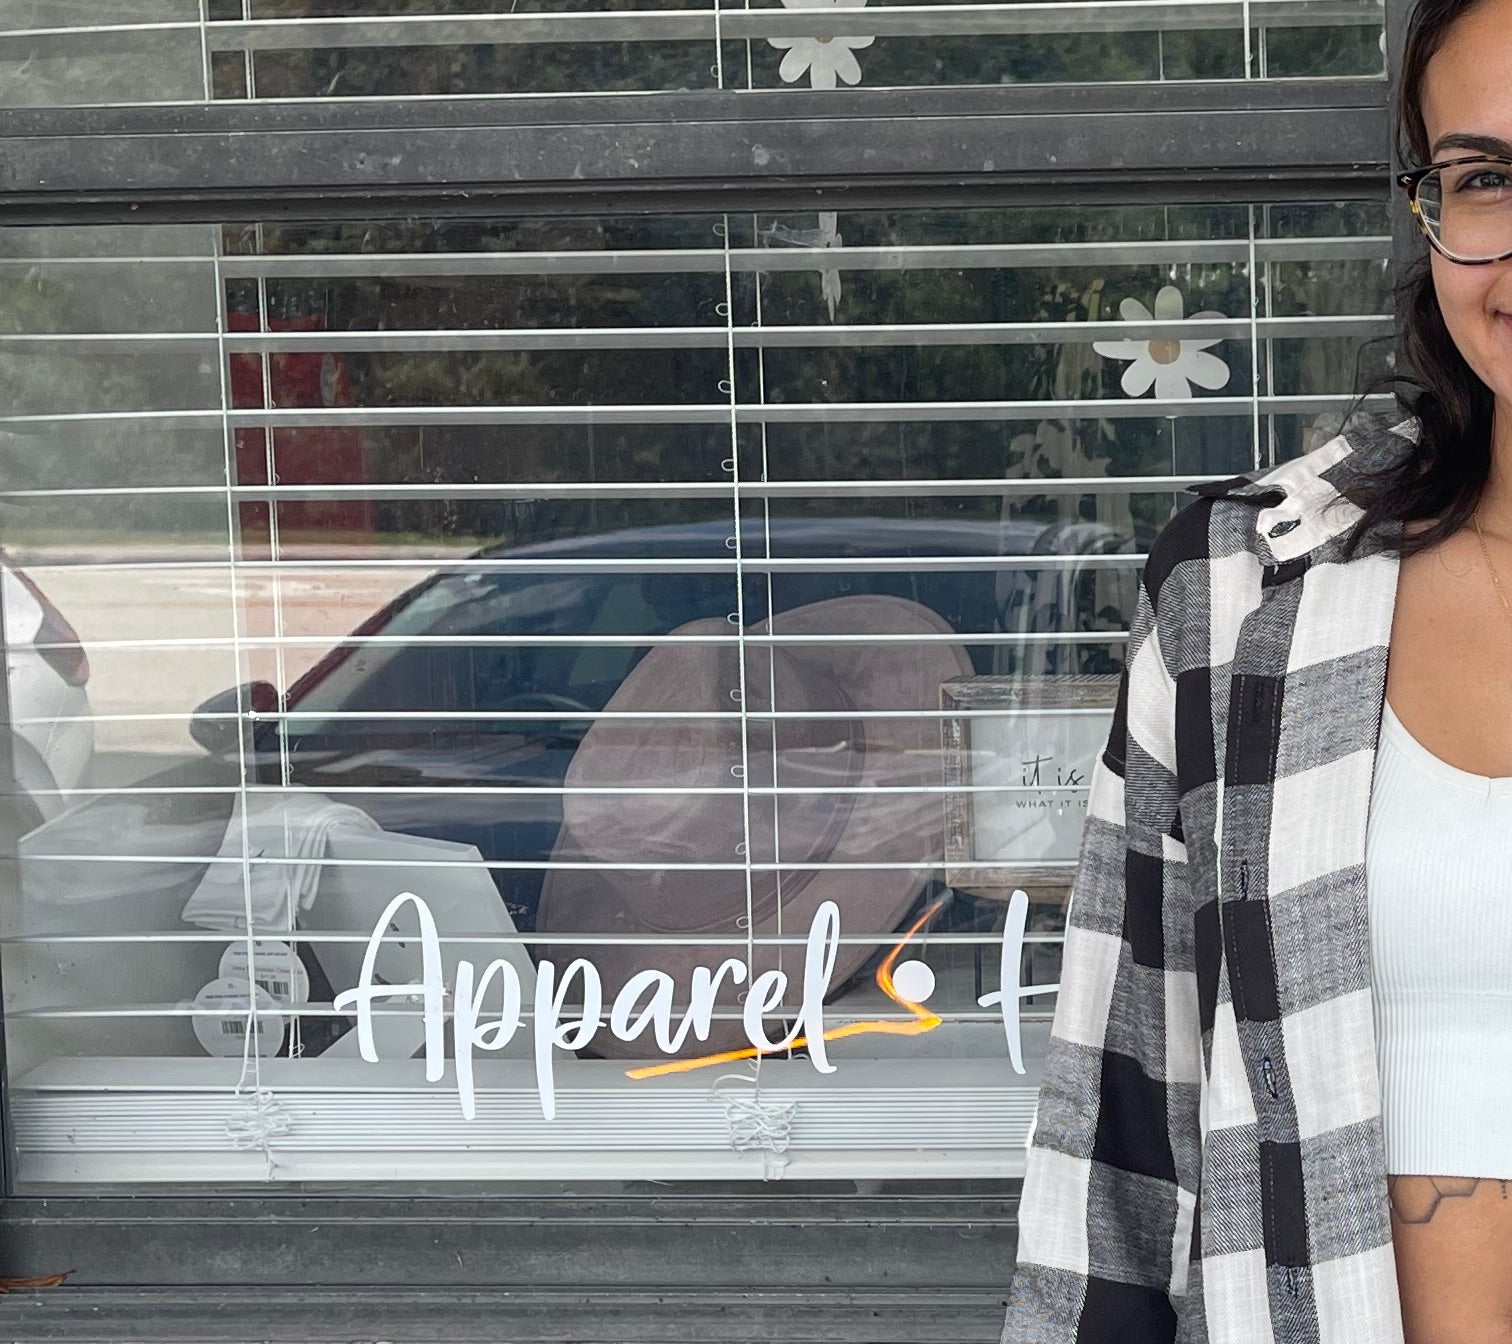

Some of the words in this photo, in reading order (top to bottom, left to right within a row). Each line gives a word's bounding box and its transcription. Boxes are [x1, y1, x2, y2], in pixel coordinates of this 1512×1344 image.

[1015, 799, 1054, 808] WHAT
[1060, 799, 1072, 807] IT
[333, 892, 838, 1121] Apparel
